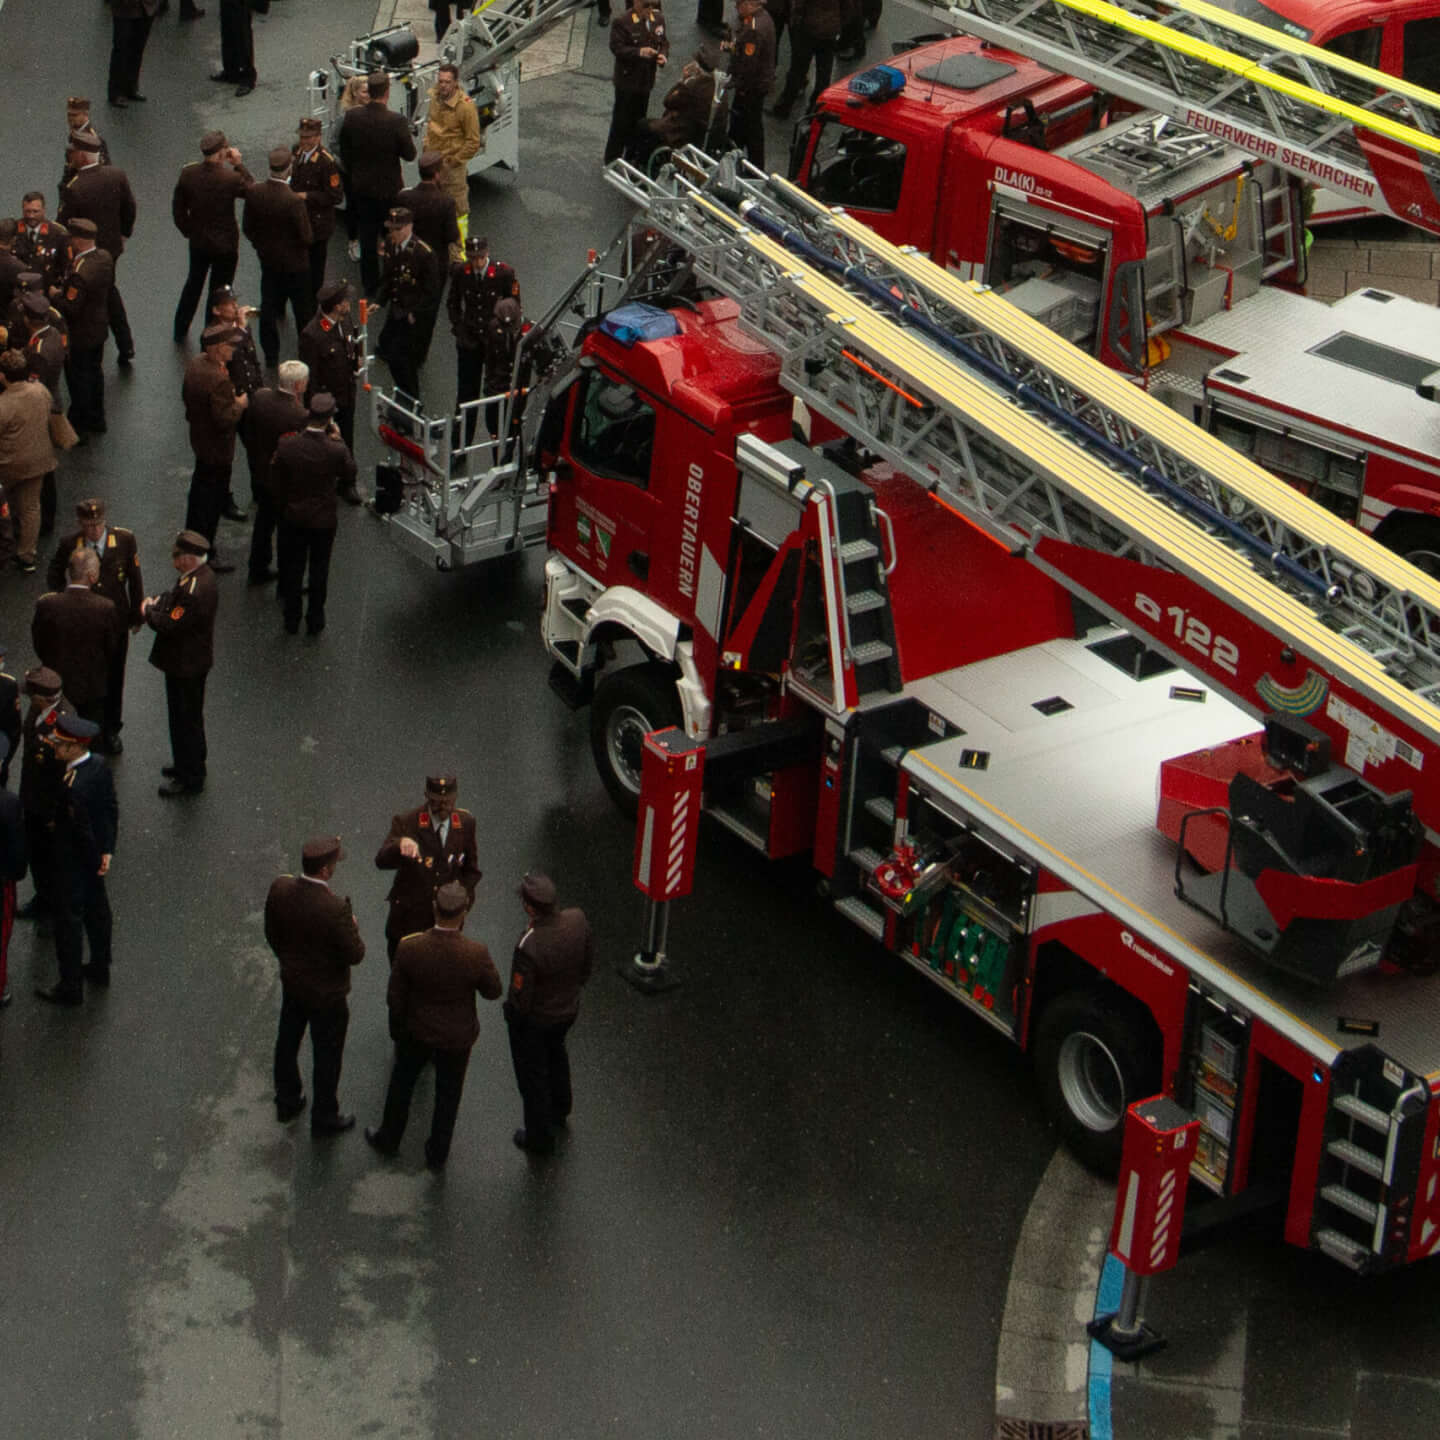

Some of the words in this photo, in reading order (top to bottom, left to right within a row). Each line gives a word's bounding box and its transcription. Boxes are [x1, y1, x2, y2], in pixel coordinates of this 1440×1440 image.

[994, 166, 1035, 192] DLA(K)
[1186, 109, 1278, 158] FEUERWEHR
[1280, 147, 1375, 198] SEEKIRCHEN
[678, 462, 704, 599] OBERTAUERN
